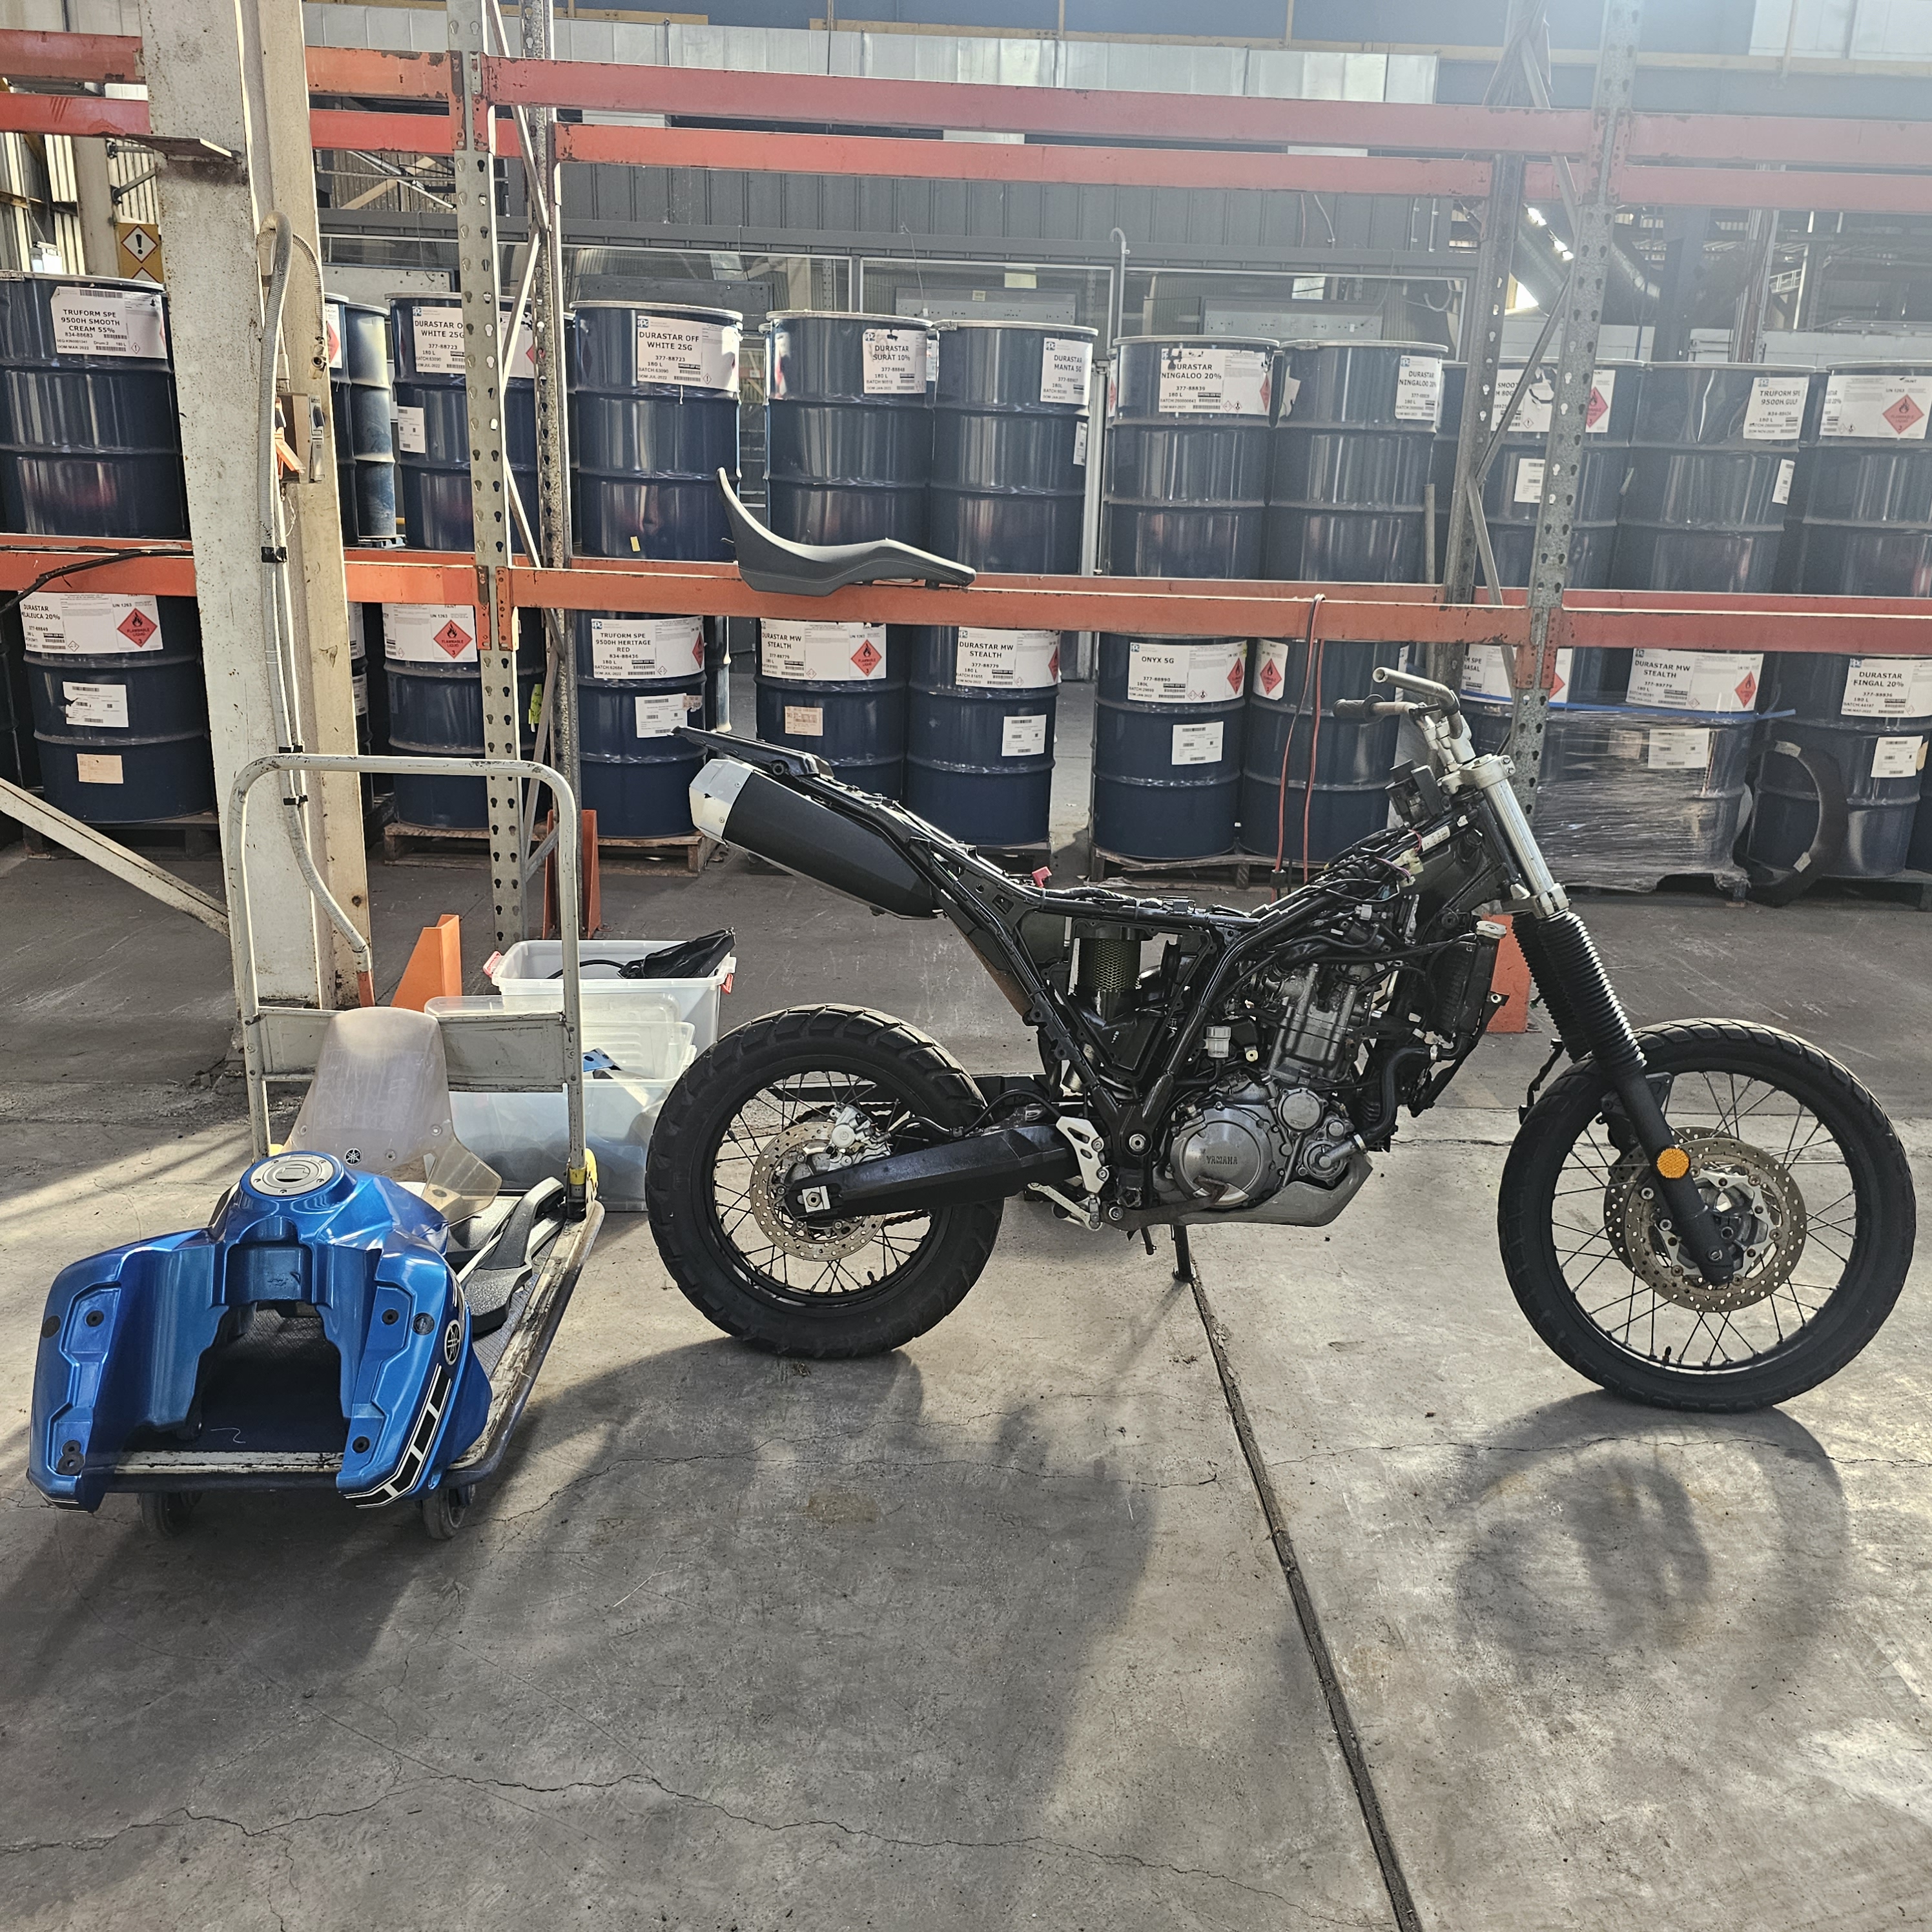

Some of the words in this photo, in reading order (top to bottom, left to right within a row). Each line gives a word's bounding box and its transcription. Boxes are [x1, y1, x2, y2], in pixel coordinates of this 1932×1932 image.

[415, 320, 454, 329] DURASTAR
[639, 331, 683, 341] DURASTAR
[647, 341, 675, 349] WHITE
[1054, 355, 1082, 364] DURASTAR
[762, 632, 788, 641] DURASTAR
[767, 641, 792, 650] STEALTH
[959, 641, 998, 650] DURASTAR
[1635, 660, 1674, 670] DURASTAR
[1643, 670, 1677, 679] STEALTH
[1206, 1155, 1238, 1165] YAMAHA
